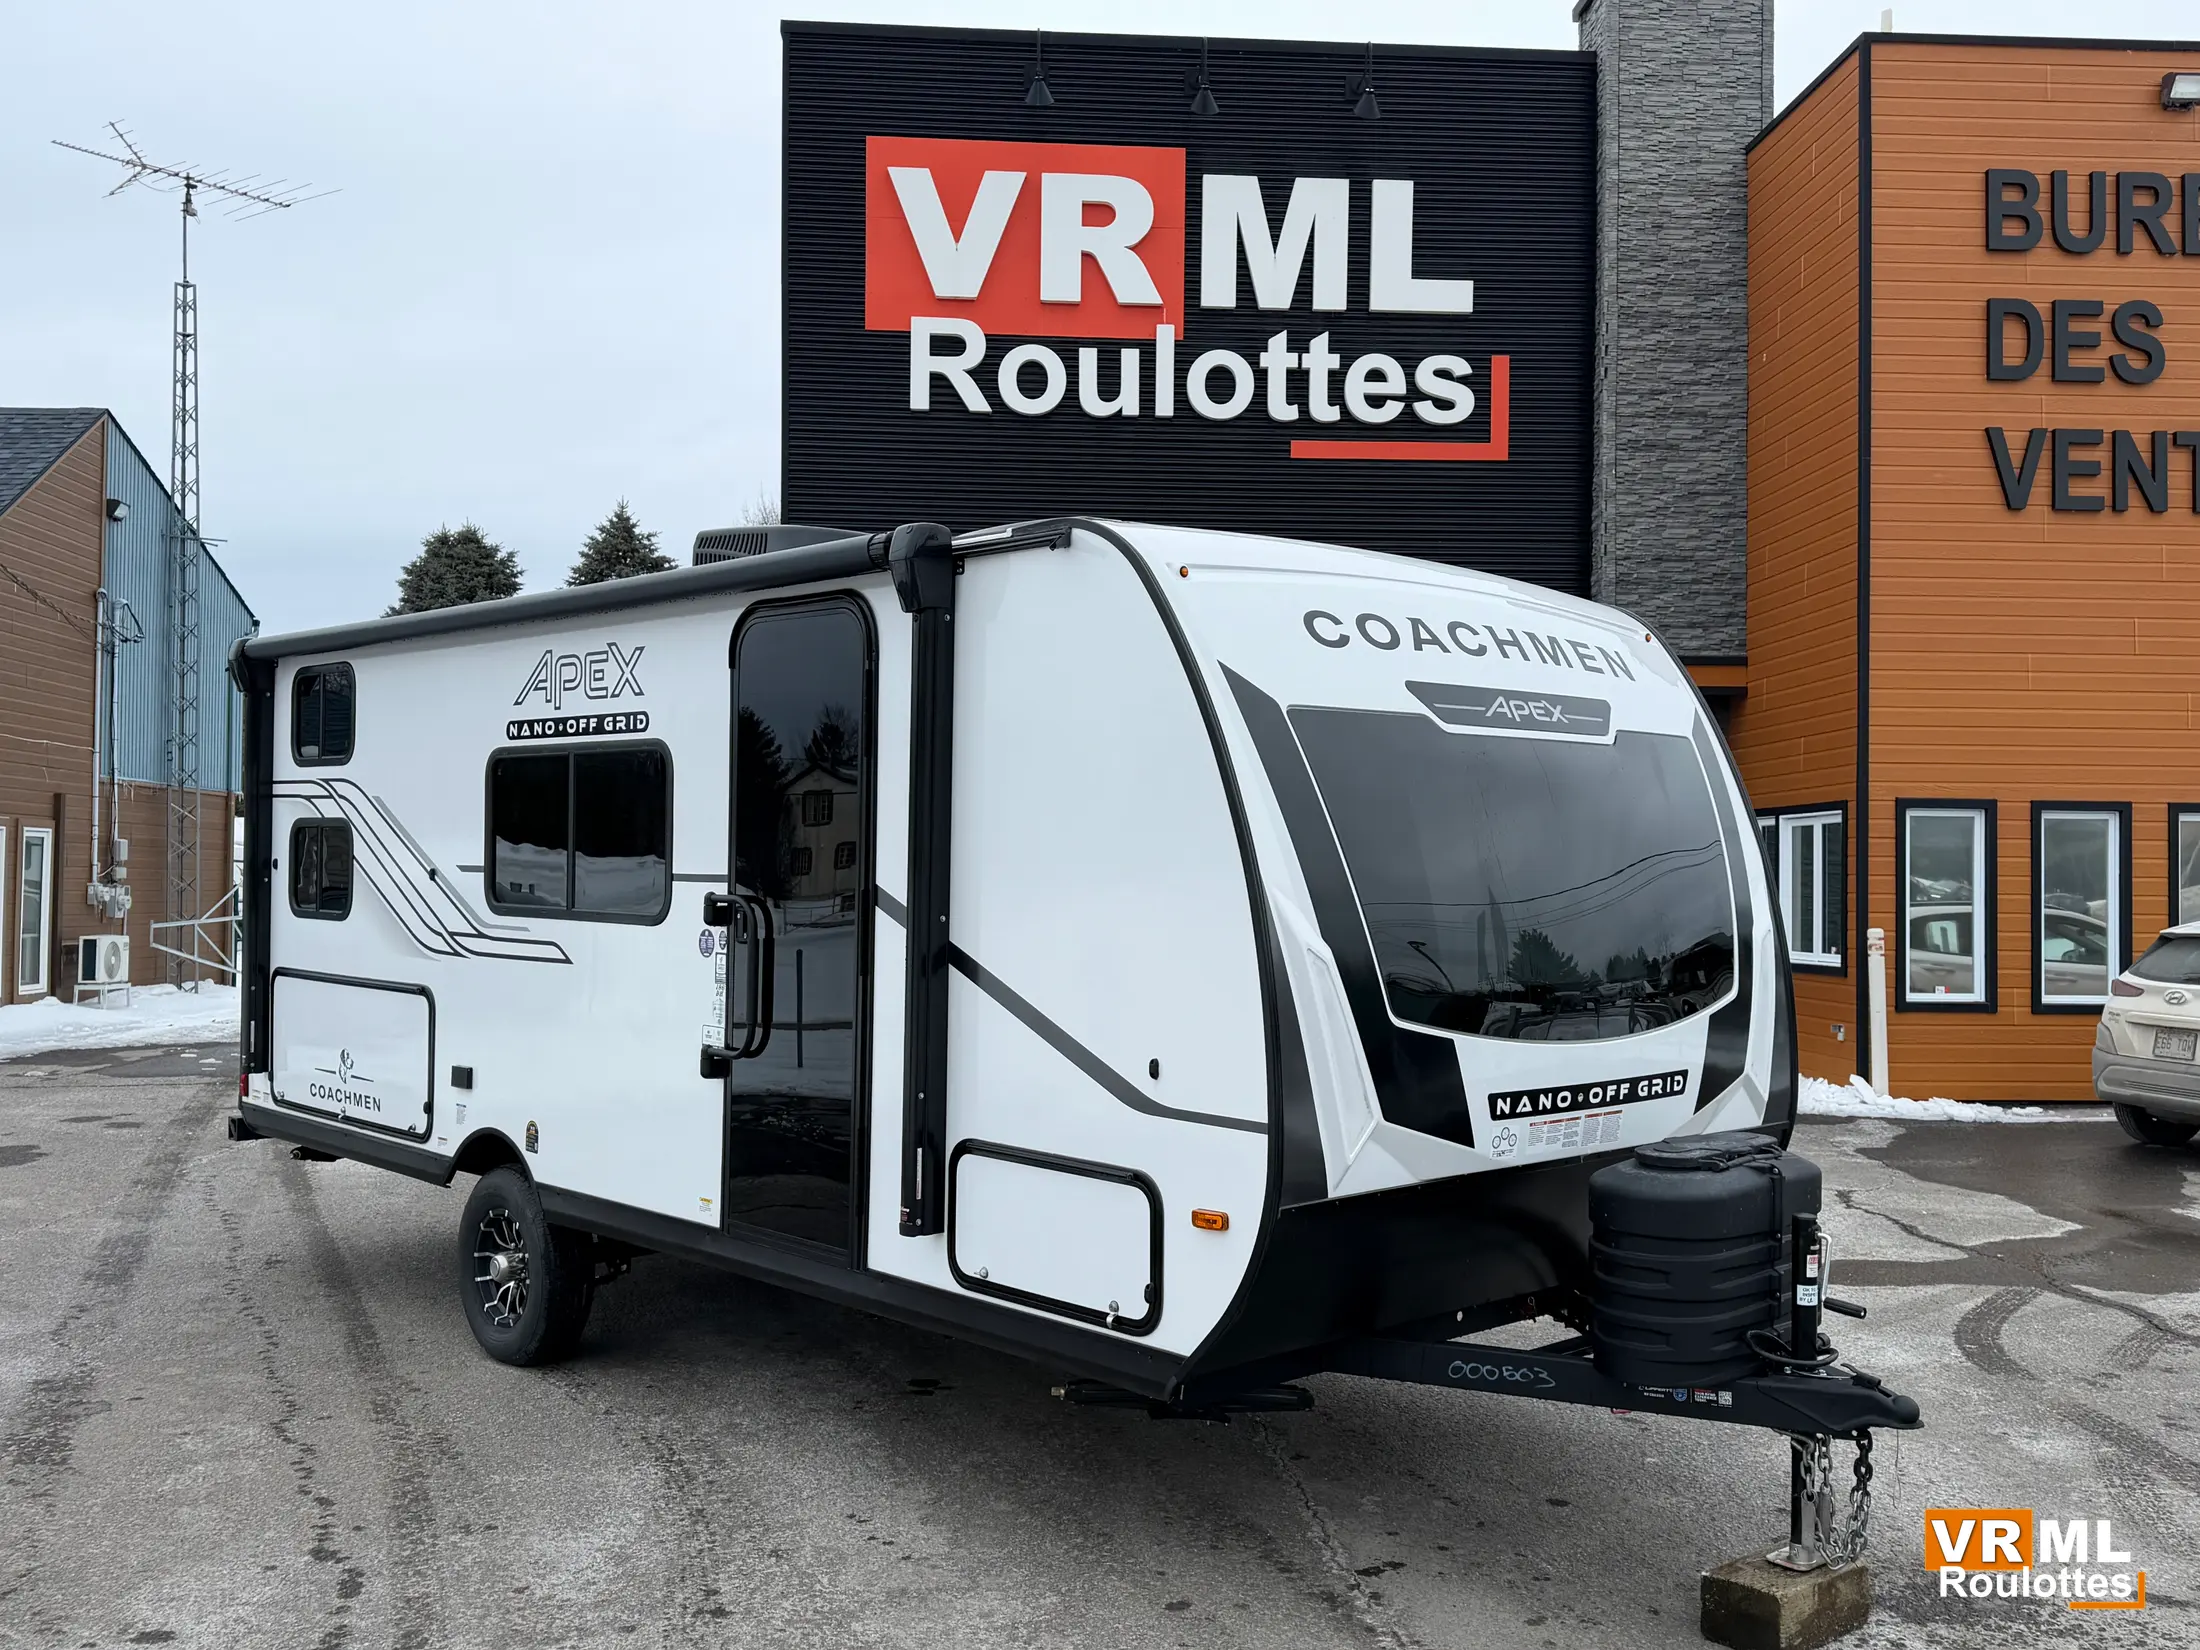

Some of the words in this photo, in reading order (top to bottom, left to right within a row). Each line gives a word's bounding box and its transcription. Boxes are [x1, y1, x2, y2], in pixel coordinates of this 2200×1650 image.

[888, 167, 1475, 314] VRML
[909, 316, 1476, 426] Roulottes
[1985, 298, 2166, 385] DES
[1302, 609, 1637, 682] COACHMEN
[509, 721, 555, 737] NANO
[566, 718, 598, 734] OFF
[604, 714, 647, 731] GRID
[309, 1082, 381, 1113] COACHMEN
[1496, 1091, 1571, 1115] NANO
[1589, 1082, 1630, 1103] OFF
[1637, 1074, 1684, 1097] GRID
